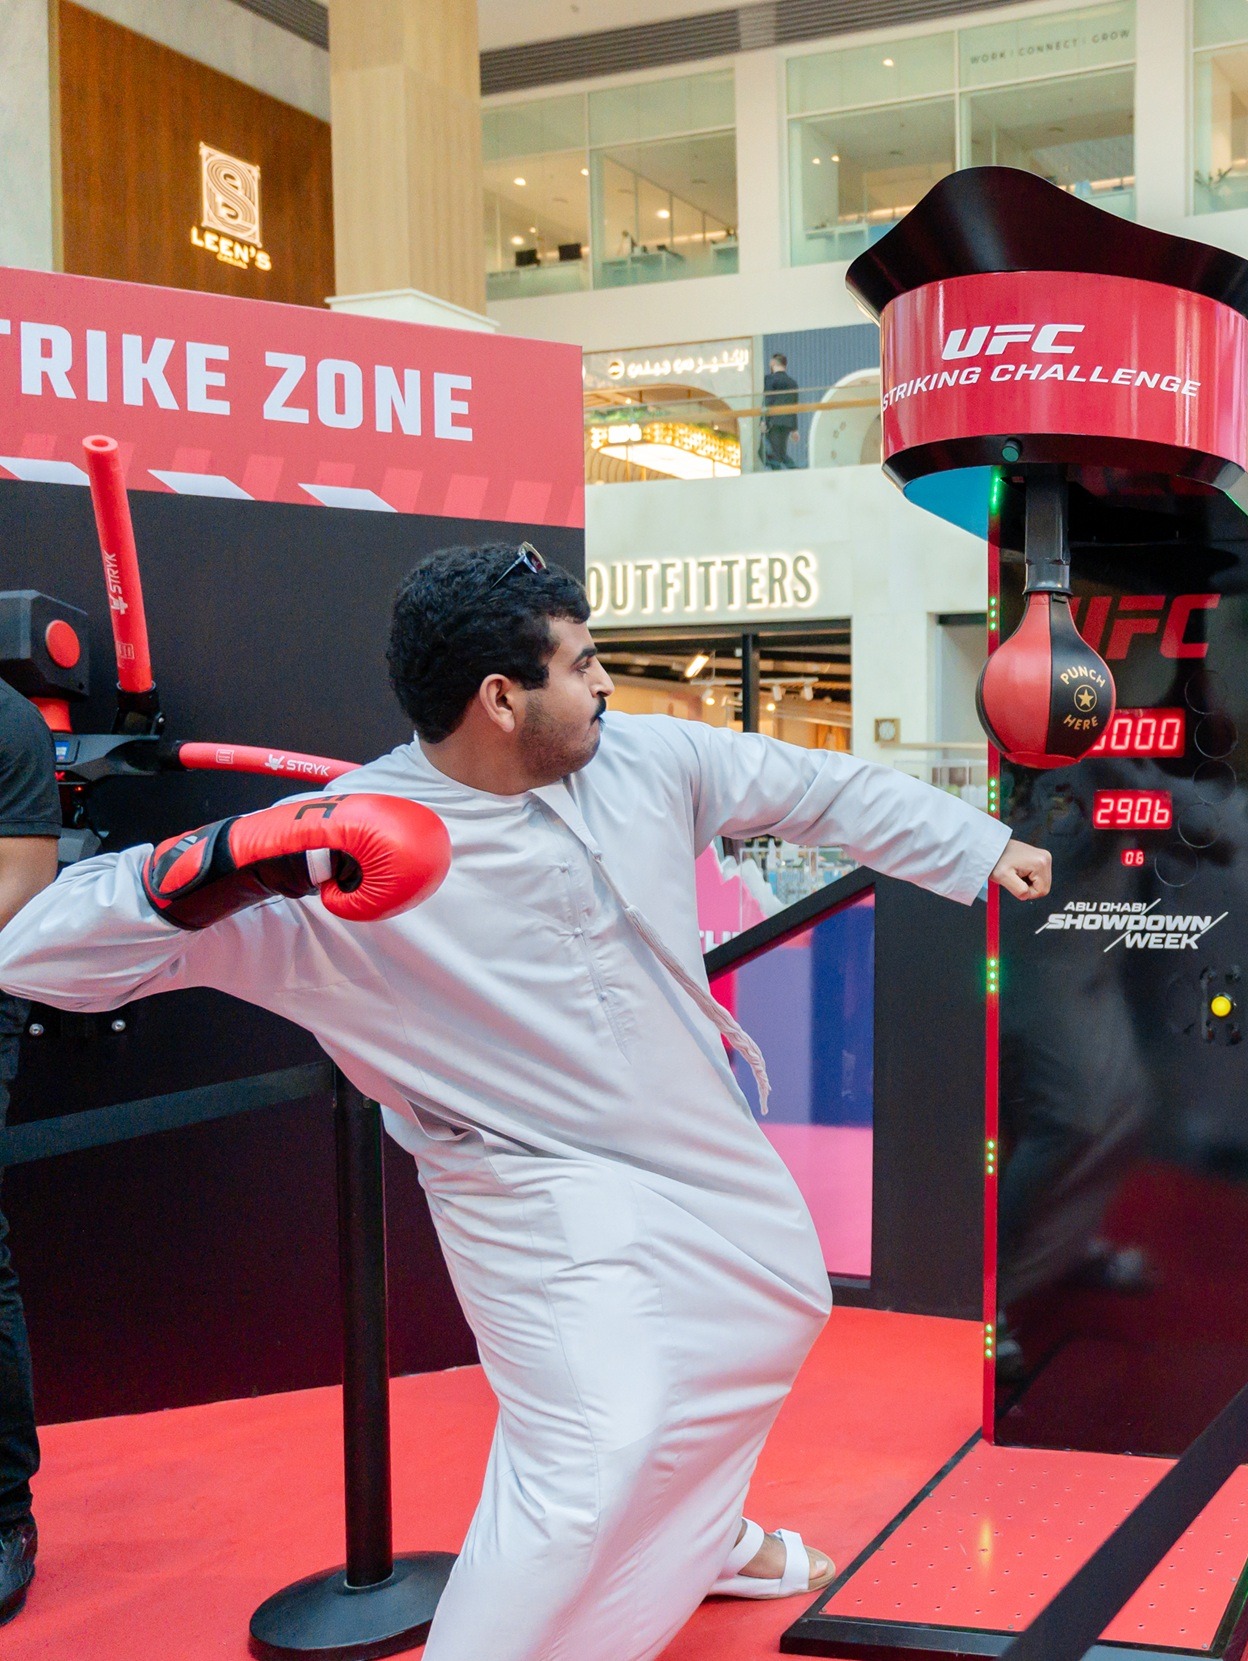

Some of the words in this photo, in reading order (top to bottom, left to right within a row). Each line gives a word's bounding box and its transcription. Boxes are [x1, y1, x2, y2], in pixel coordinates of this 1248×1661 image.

[1018, 38, 1078, 56] CONNECT
[191, 225, 272, 271] LEEN'S
[941, 324, 1085, 361] UFC
[0, 319, 230, 416] RIKE
[263, 351, 473, 441] ZONE
[883, 367, 981, 411] STRIKING
[990, 364, 1201, 397] CHALLENGE
[104, 551, 122, 595] STRYK
[586, 553, 815, 613] OUTFITTERS
[1060, 665, 1106, 687] PUNCH
[1063, 714, 1099, 731] HERE
[1093, 719, 1180, 749] 000
[286, 759, 331, 776] STRYK
[1064, 901, 1097, 912] ABU
[1099, 902, 1146, 913] DHABI
[1046, 914, 1212, 931] SHOWDOWN
[1125, 933, 1201, 949] WEEK
